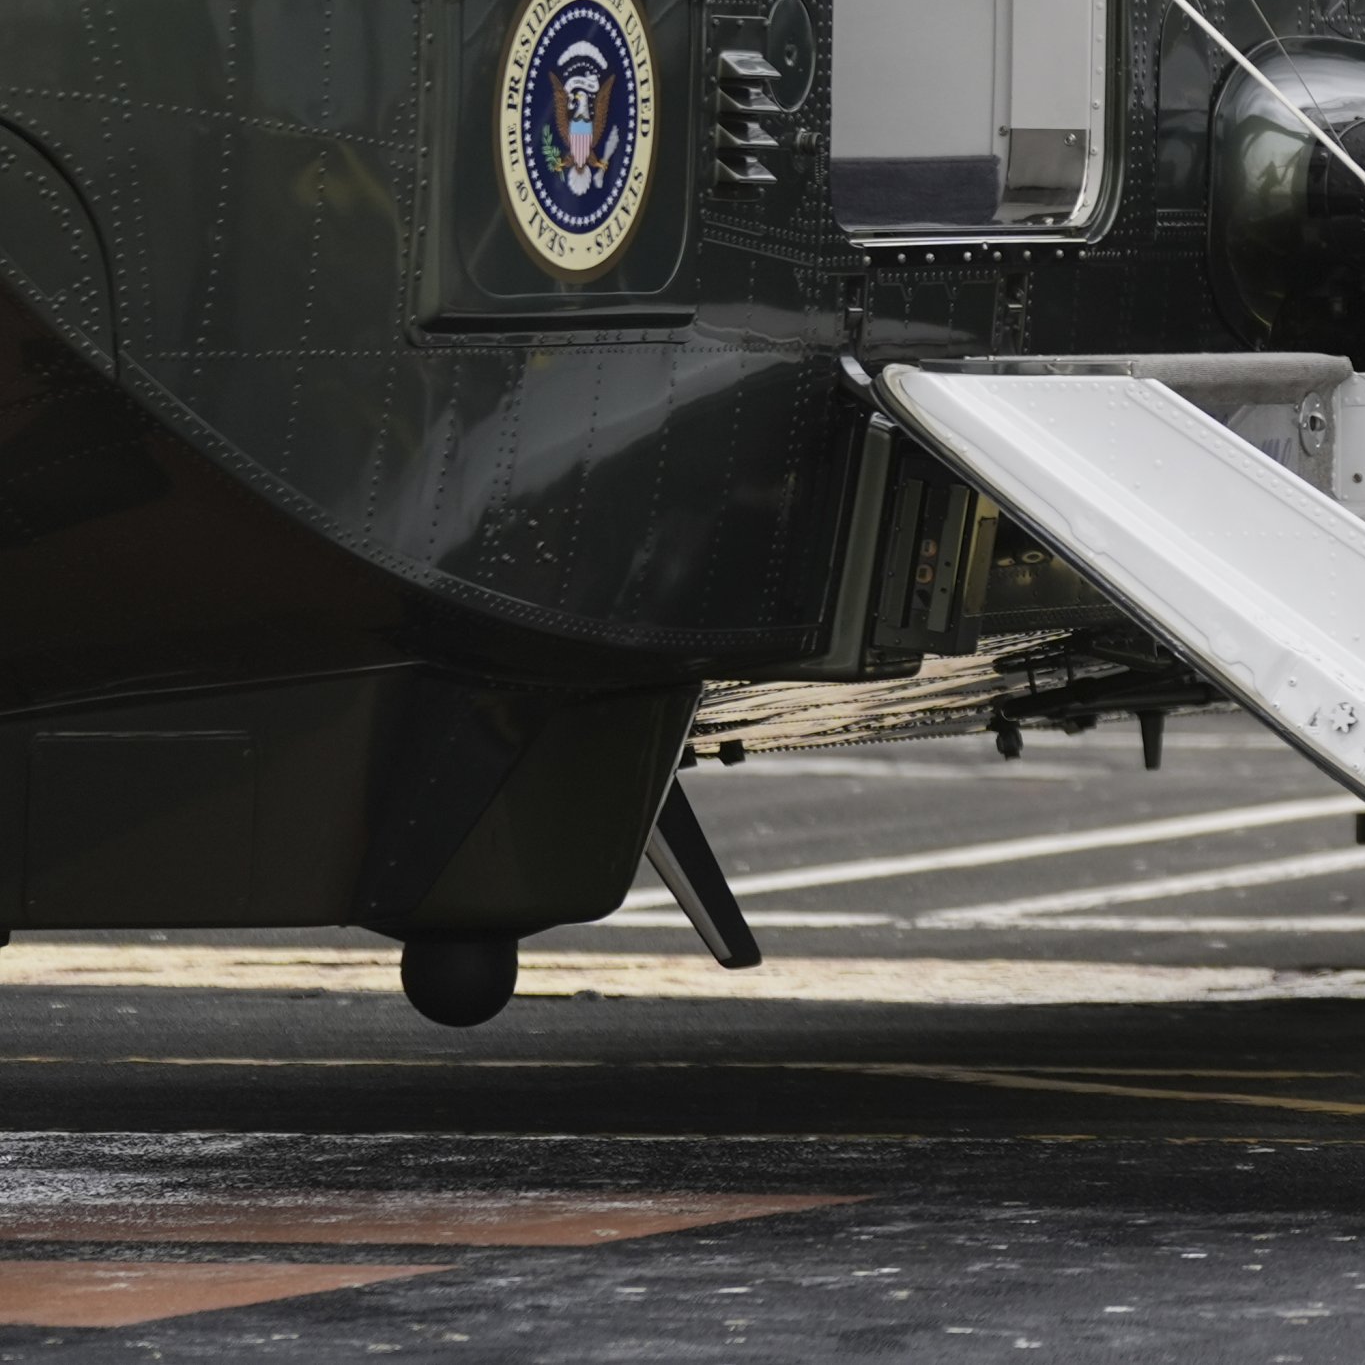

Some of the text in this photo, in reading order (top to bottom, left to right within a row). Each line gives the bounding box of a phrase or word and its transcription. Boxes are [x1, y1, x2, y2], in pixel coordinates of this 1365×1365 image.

[625, 14, 652, 139] UNITED
[507, 123, 522, 172] THE
[516, 179, 529, 202] OF
[595, 167, 643, 256] STATES
[530, 201, 568, 257] SEAL
